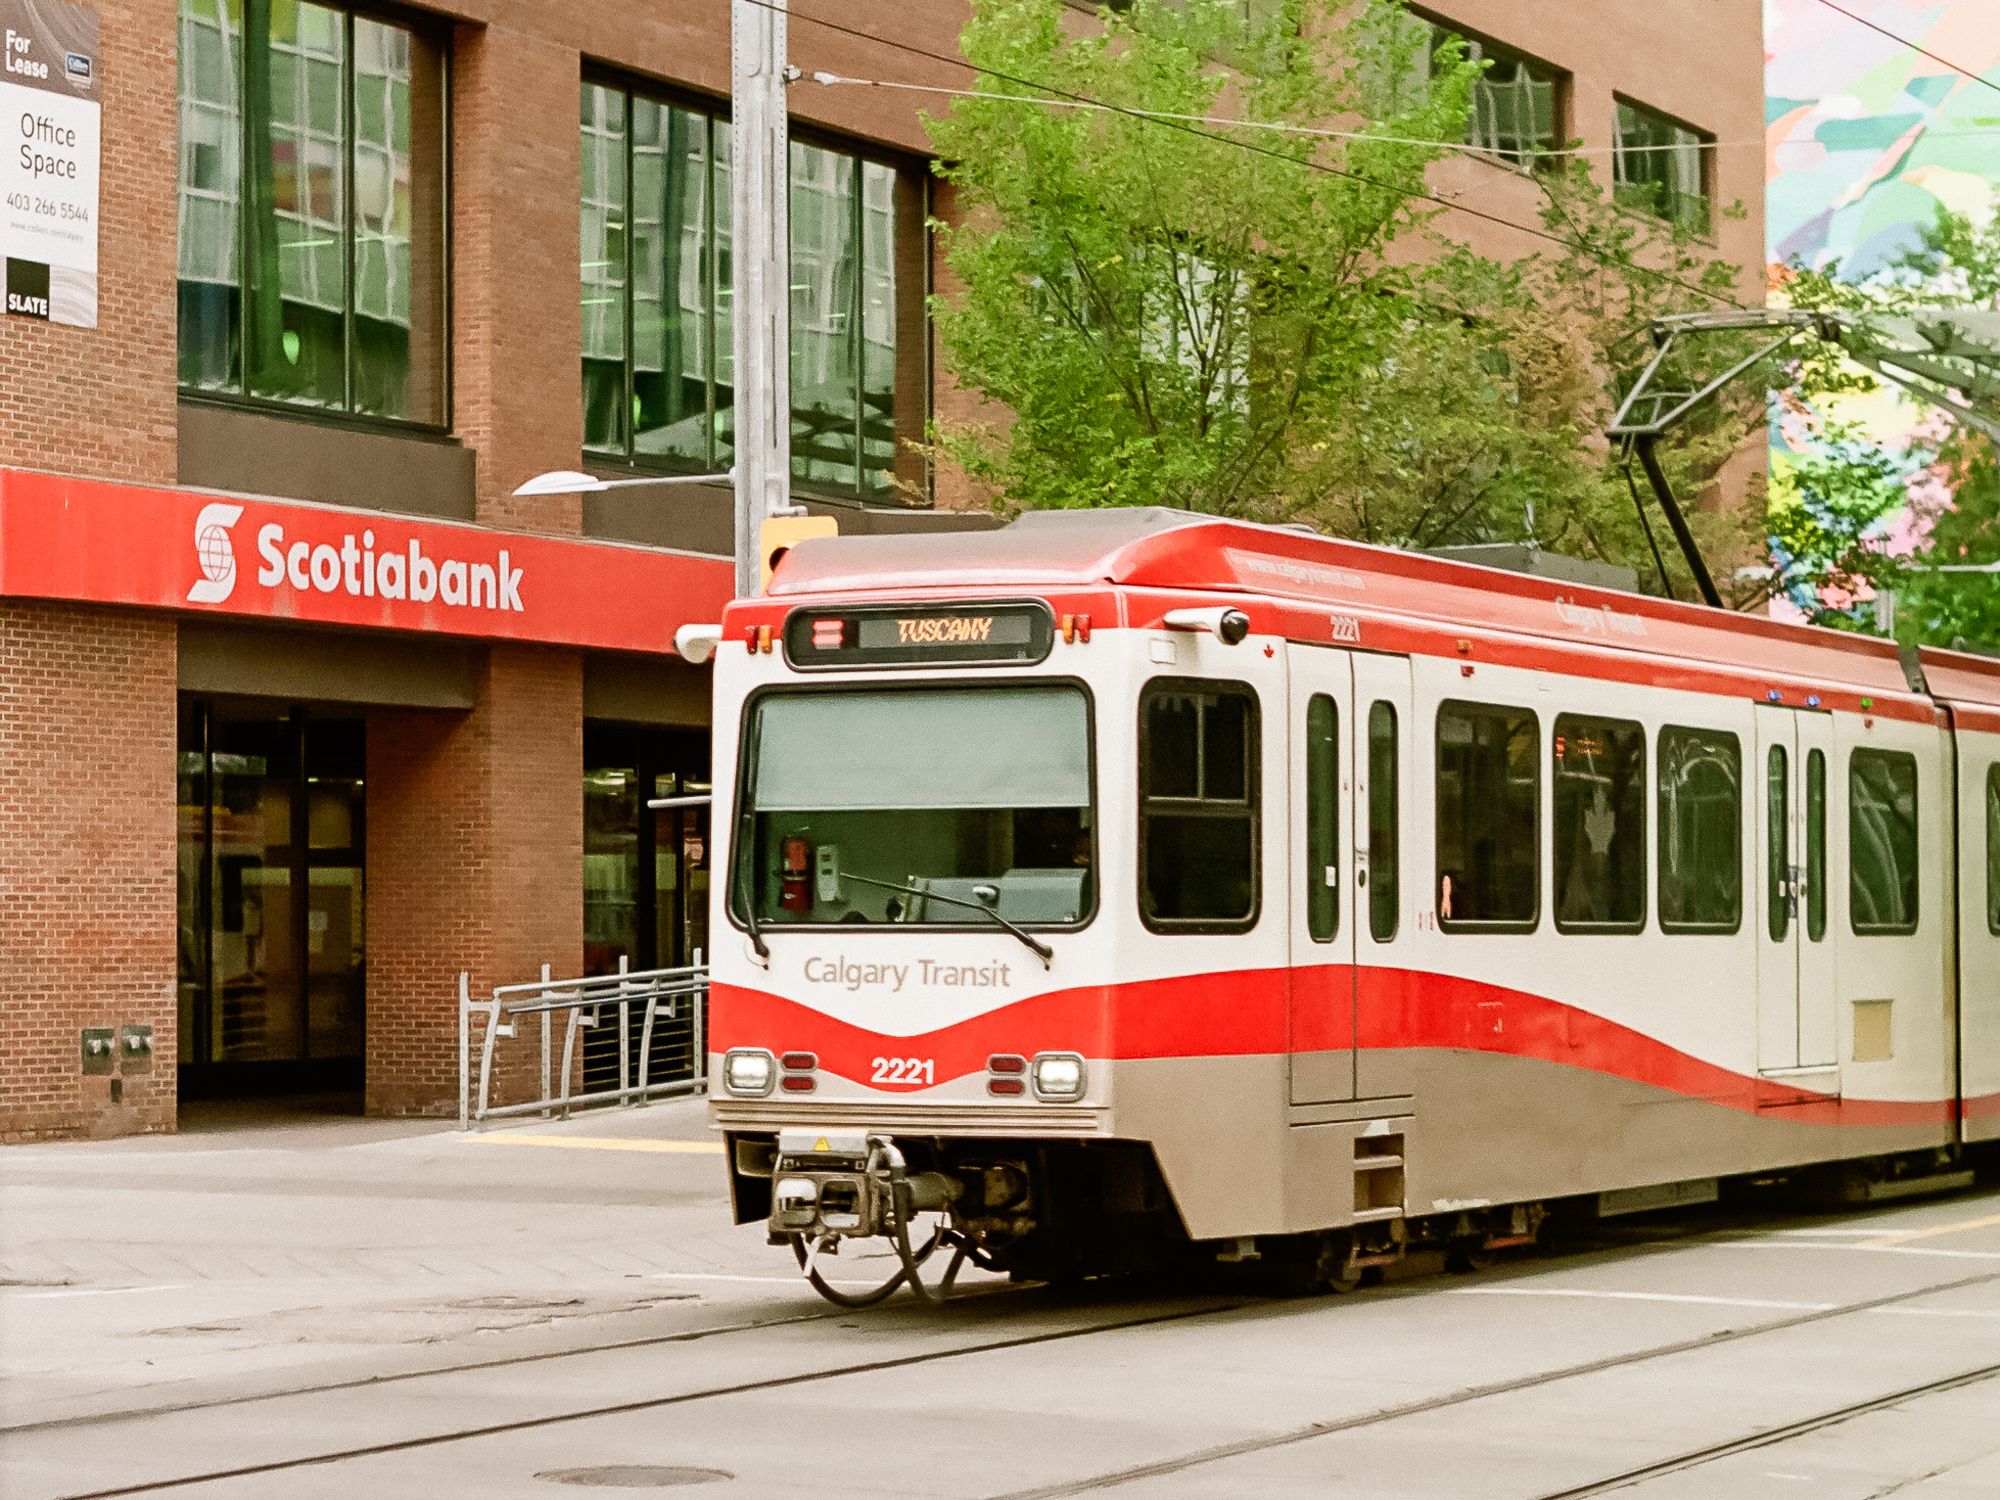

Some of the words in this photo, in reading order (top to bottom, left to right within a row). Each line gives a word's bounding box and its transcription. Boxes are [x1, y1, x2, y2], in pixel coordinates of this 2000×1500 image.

[6, 29, 31, 54] For
[6, 50, 48, 79] Lease
[21, 112, 75, 147] Office
[20, 144, 76, 179] Space
[6, 192, 30, 211] 403
[35, 197, 57, 217] 266
[60, 202, 88, 222] 5544
[8, 293, 48, 316] SLATE
[257, 523, 524, 612] Scotiabank
[897, 617, 993, 643] TUSCANY
[1329, 615, 1360, 642] 2221
[804, 955, 909, 993] Calgary
[917, 959, 1011, 988] Transit
[871, 1057, 934, 1084] 2221
